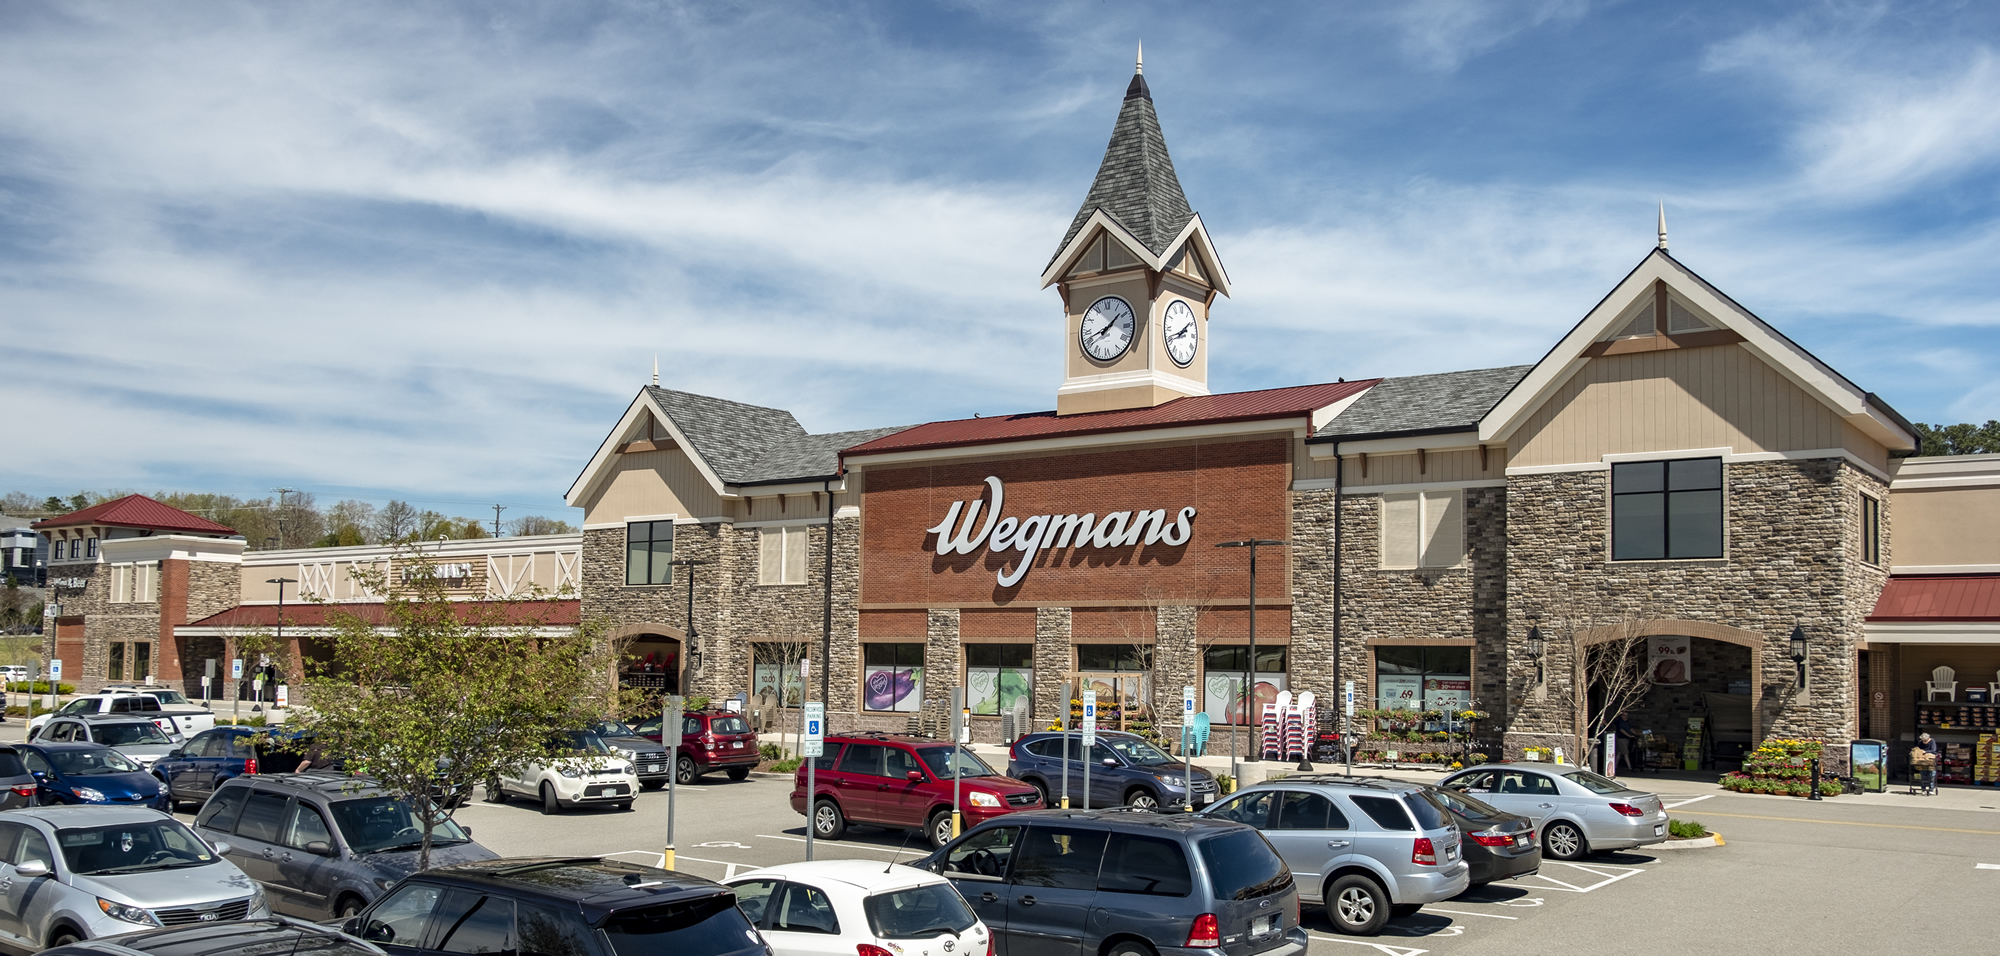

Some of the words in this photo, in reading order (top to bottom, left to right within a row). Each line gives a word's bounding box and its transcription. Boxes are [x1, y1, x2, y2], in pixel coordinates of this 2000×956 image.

[927, 476, 1197, 587] Wegmans
[401, 563, 473, 580] PMACY
[1399, 689, 1413, 699] .69
[203, 913, 217, 921] KIA
